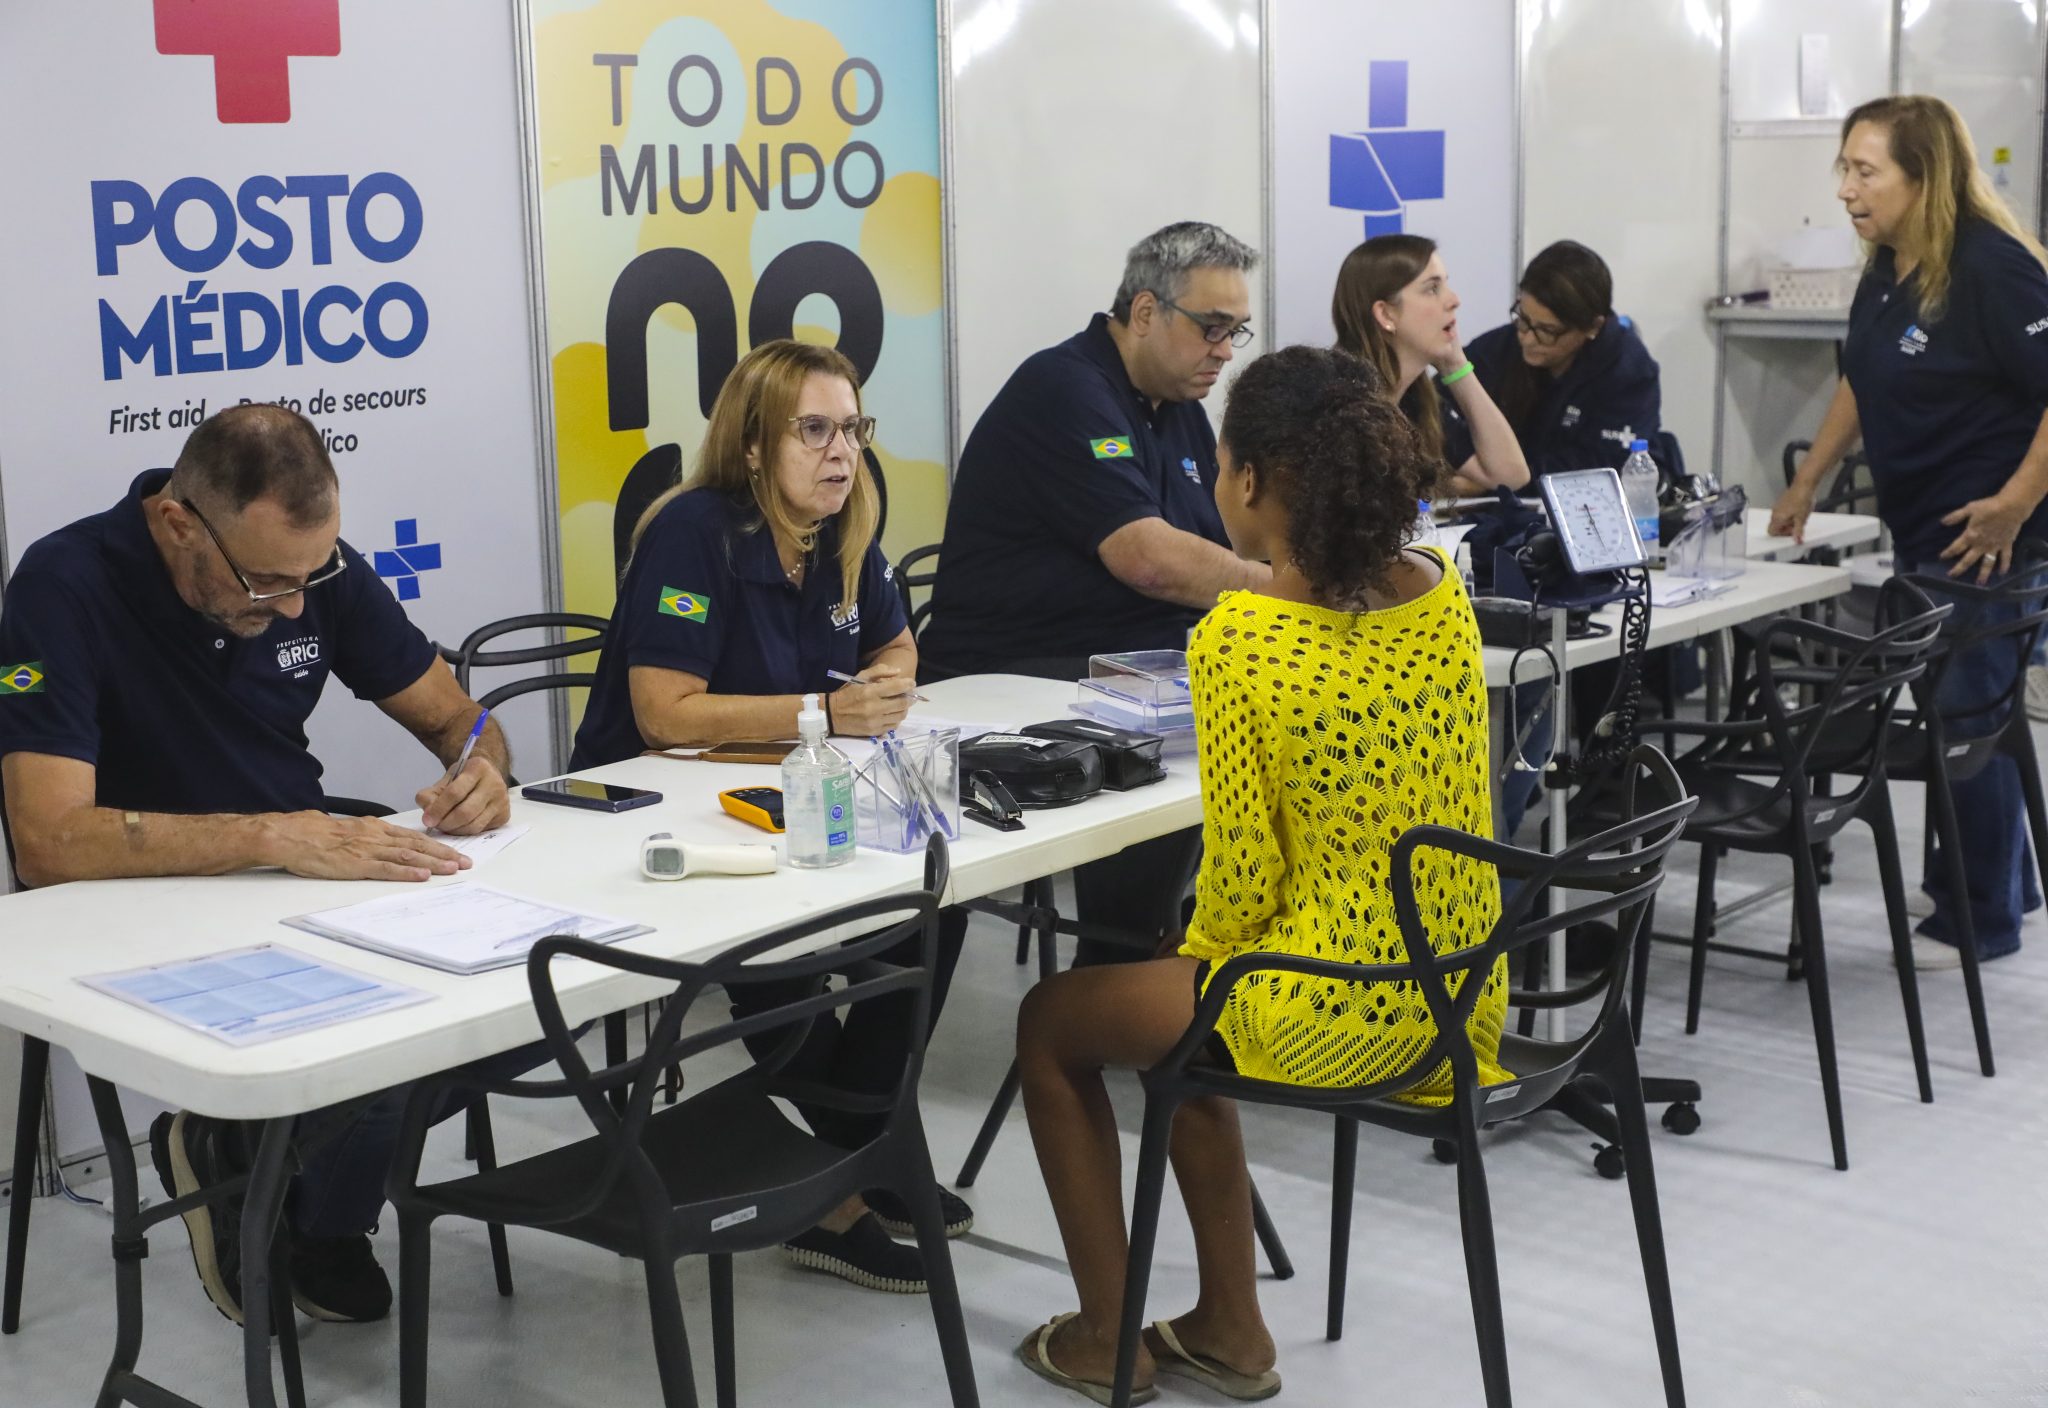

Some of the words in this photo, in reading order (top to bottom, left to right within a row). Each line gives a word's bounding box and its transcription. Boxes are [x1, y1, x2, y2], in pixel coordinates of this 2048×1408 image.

[593, 53, 884, 128] TODO
[600, 140, 885, 216] MUNDO
[90, 171, 423, 276] POSTO
[98, 280, 429, 381] MÉDICO
[108, 405, 161, 434] First
[167, 398, 207, 428] aid
[308, 388, 338, 415] de
[342, 386, 427, 412] secours
[290, 643, 319, 664] RIO
